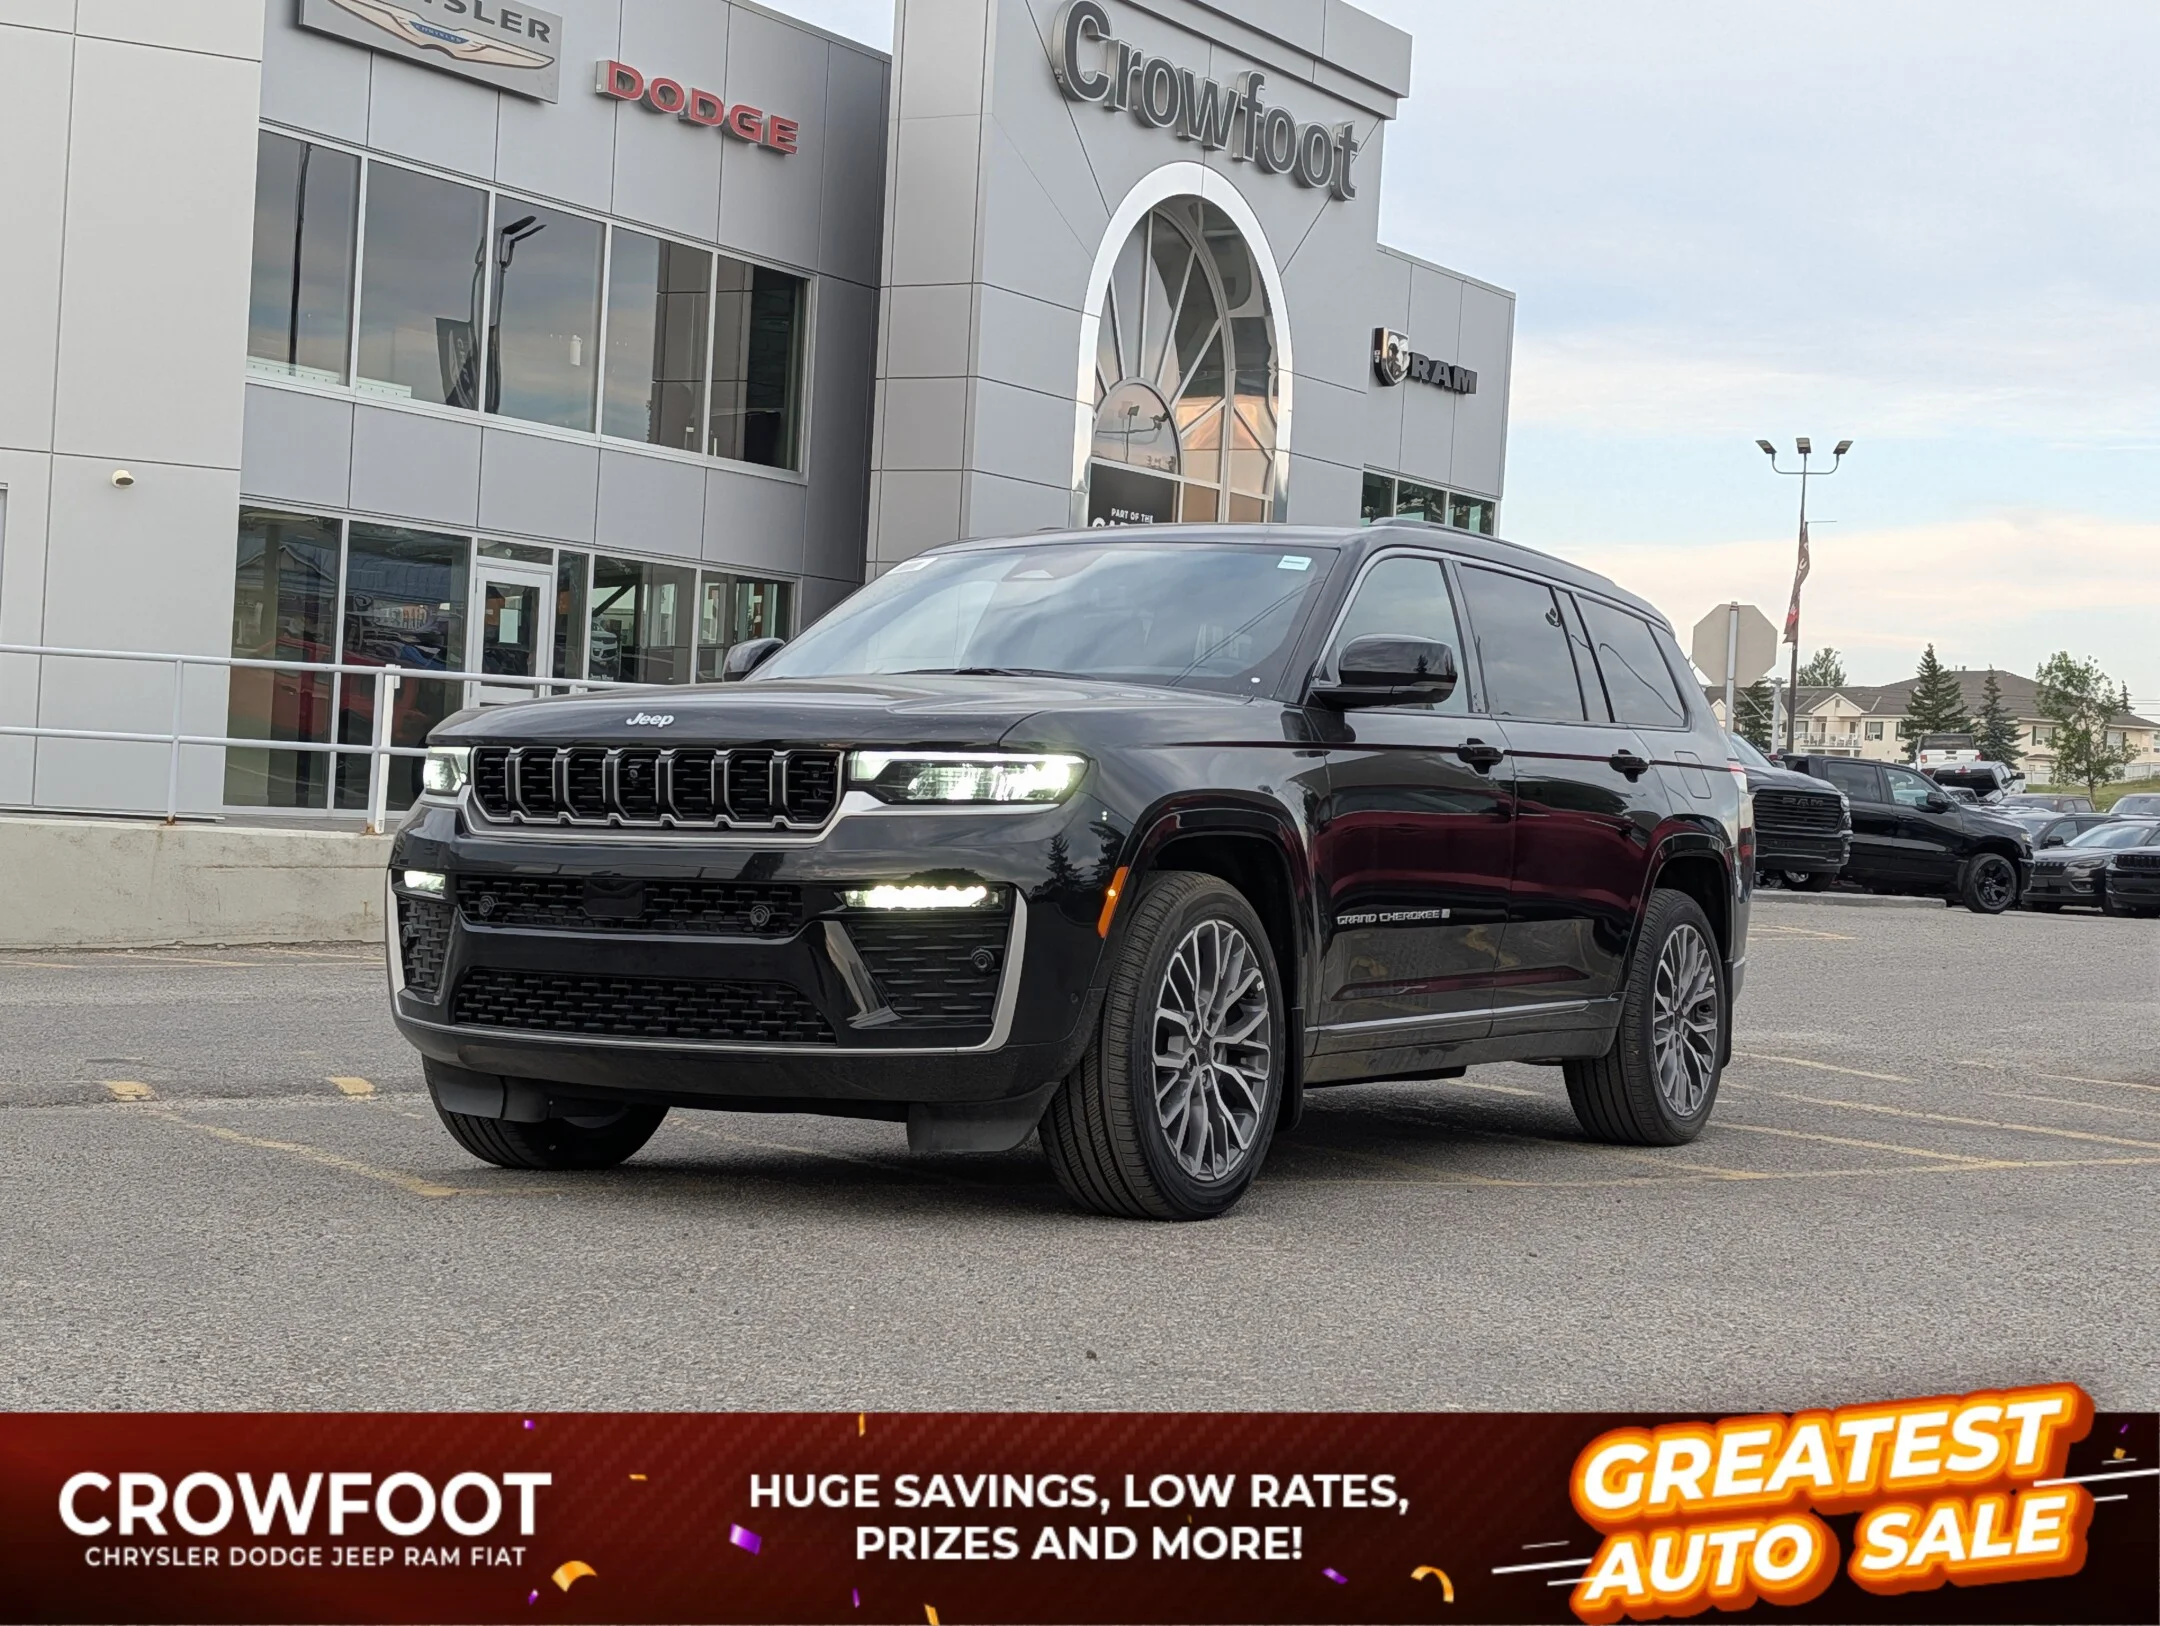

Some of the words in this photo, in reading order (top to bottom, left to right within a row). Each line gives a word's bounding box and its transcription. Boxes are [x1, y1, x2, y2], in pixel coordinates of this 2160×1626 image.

[423, 0, 551, 43] SLER
[604, 60, 798, 154] DODGE
[1056, 0, 1358, 200] Crowfoot
[1410, 352, 1477, 394] RAM
[1111, 507, 1129, 519] PART
[1130, 511, 1139, 521] OF
[626, 712, 675, 728] Jeep
[1337, 914, 1377, 925] GRAND
[1379, 910, 1440, 922] CHEROKEE
